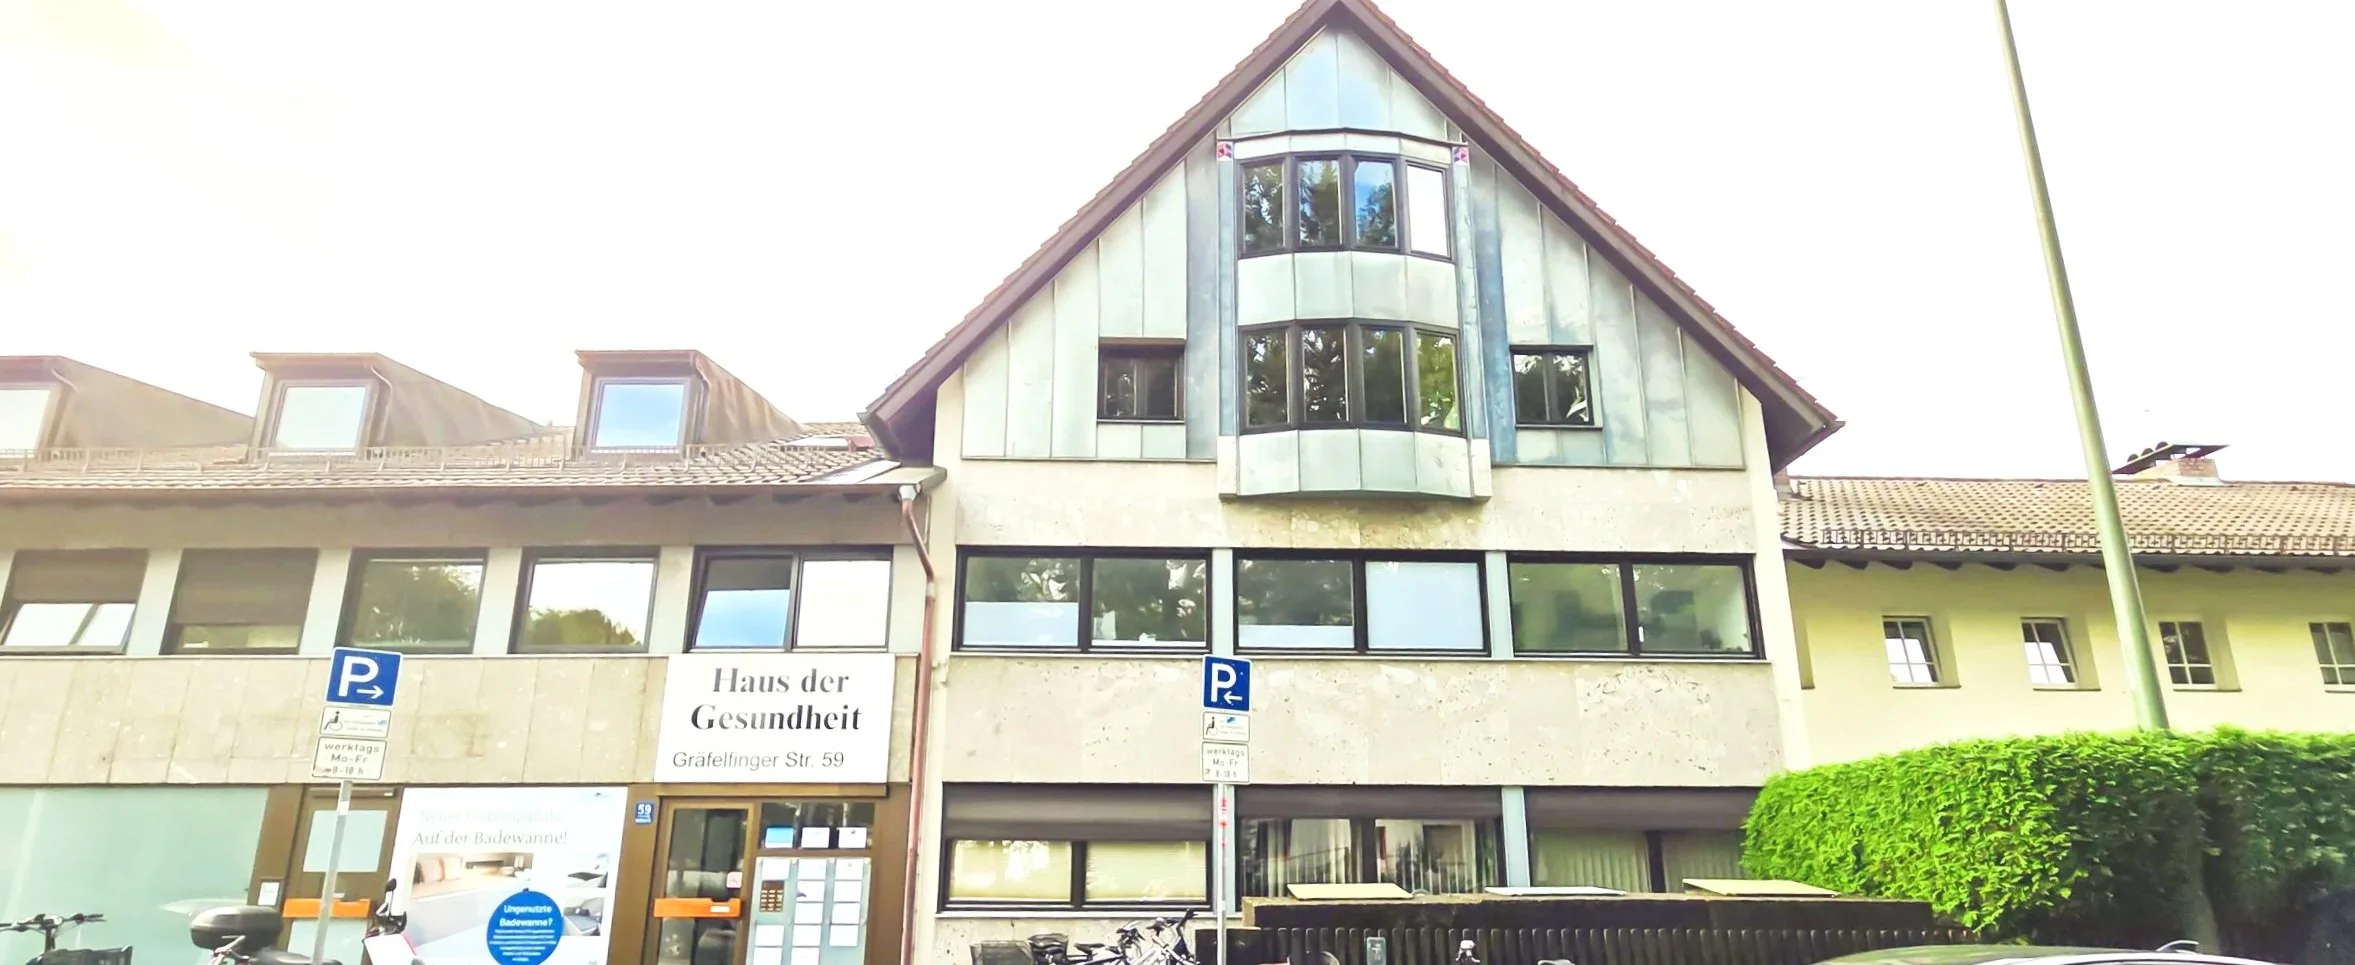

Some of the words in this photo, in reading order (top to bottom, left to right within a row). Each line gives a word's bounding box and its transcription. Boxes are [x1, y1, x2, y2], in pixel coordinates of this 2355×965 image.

[338, 655, 379, 697] P
[712, 667, 790, 693] Haus
[800, 667, 850, 693] der
[1211, 662, 1237, 703] P
[691, 703, 862, 730] Gesundheit
[324, 743, 380, 755] werktags
[1206, 747, 1245, 758] werktags
[331, 753, 369, 764] Mo-Fr
[673, 751, 779, 771] Gräfelfinger
[785, 751, 814, 768] Str.
[821, 751, 844, 768] 59
[637, 803, 652, 815] 59
[412, 830, 442, 846] Auf
[444, 830, 468, 846] der
[474, 829, 568, 846] Badewanne!
[503, 904, 553, 915] Ungenutzte
[499, 917, 553, 927] Badewanne?
